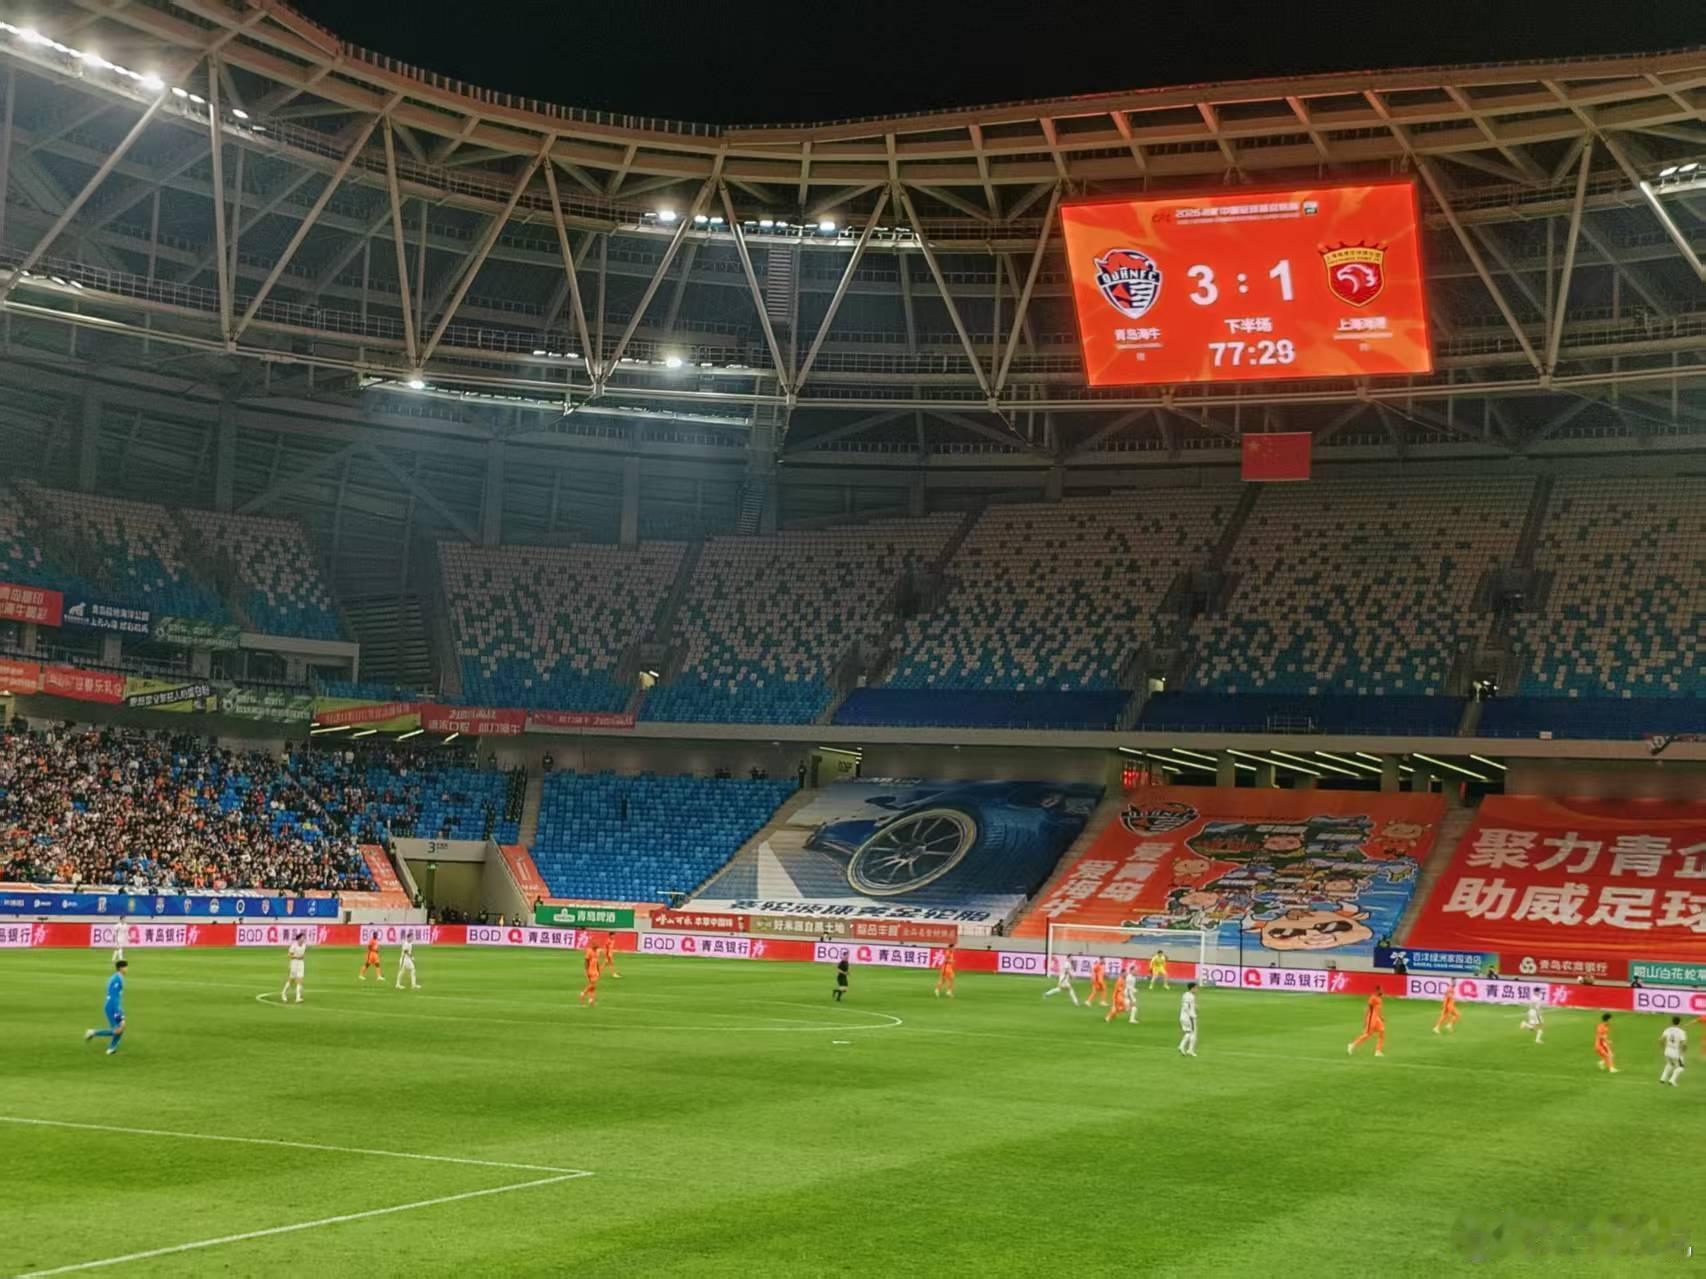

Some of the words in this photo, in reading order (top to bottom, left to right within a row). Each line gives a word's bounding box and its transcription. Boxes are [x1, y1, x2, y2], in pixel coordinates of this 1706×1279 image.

[1187, 264, 1218, 305] 3
[1269, 259, 1293, 301] 1
[1442, 877, 1706, 934] 助威足球
[577, 910, 616, 923] 青岛啤酒
[145, 928, 185, 942] 青岛银行
[238, 928, 263, 942] BQD
[469, 929, 501, 942] BQD
[528, 932, 574, 945] 青岛银行
[643, 937, 675, 950] BQD
[702, 940, 749, 954] 青岛银行
[879, 949, 929, 964] 青岛银行
[1001, 956, 1037, 970] BQD
[1269, 972, 1327, 988] 青岛银行
[1638, 993, 1681, 1009] BQD
